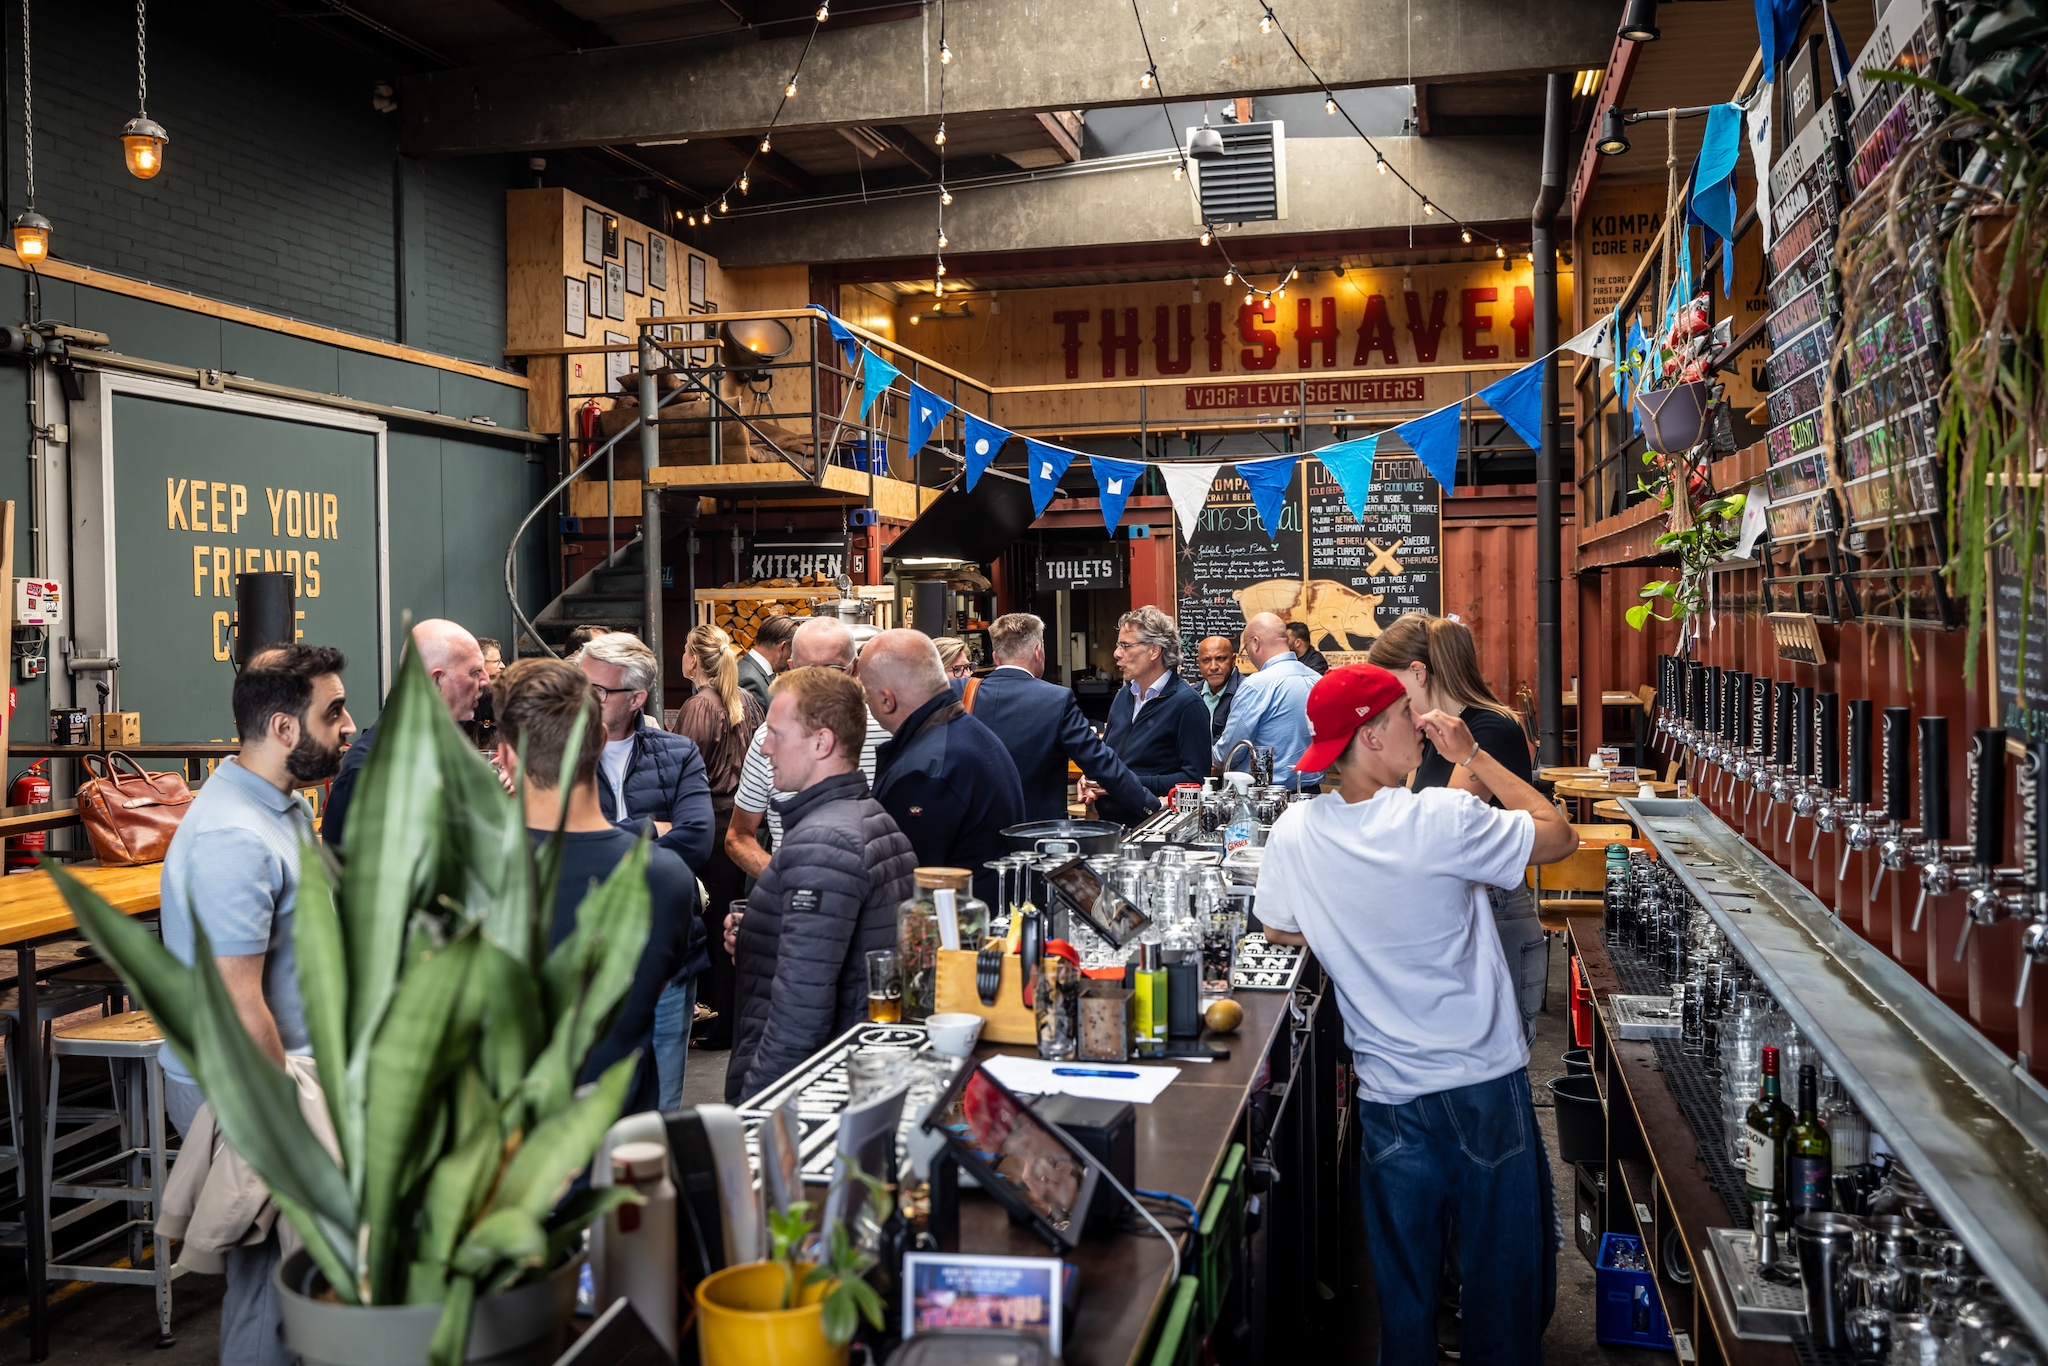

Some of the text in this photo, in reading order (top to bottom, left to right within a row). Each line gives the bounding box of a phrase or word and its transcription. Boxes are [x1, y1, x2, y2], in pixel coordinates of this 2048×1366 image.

[1875, 24, 1895, 70] LIST
[1790, 145, 1805, 177] LIST
[1592, 240, 1627, 255] CORE
[1193, 381, 1417, 406] VOOR LEVENSGENIETERS
[1788, 418, 1815, 451] BLOND
[167, 477, 338, 540] KEEP YOUR
[1412, 505, 1438, 513] TERRACE
[1178, 507, 1232, 532] RING
[1335, 515, 1379, 523] NETHERANDS
[1389, 515, 1411, 523] JAPAN
[1335, 525, 1365, 533] GERMANY
[1378, 524, 1411, 534] CURAÇAO
[1403, 536, 1430, 546] SWEDEN
[1413, 546, 1435, 554] COAST
[752, 554, 842, 579] KITCHEN
[855, 556, 863, 572] 5
[1045, 560, 1112, 579] TOILETS
[1352, 577, 1368, 586] BOOK
[1370, 576, 1385, 584] YOUR
[1412, 574, 1426, 582] AND
[1391, 585, 1406, 593] MISS
[1409, 585, 1414, 593] A
[1398, 596, 1419, 604] MINUTE
[213, 611, 306, 661] CE
[1753, 697, 1763, 752] KOMPAAN
[1227, 839, 1248, 851] Glassex
[1000, 1294, 1042, 1326] YOU
